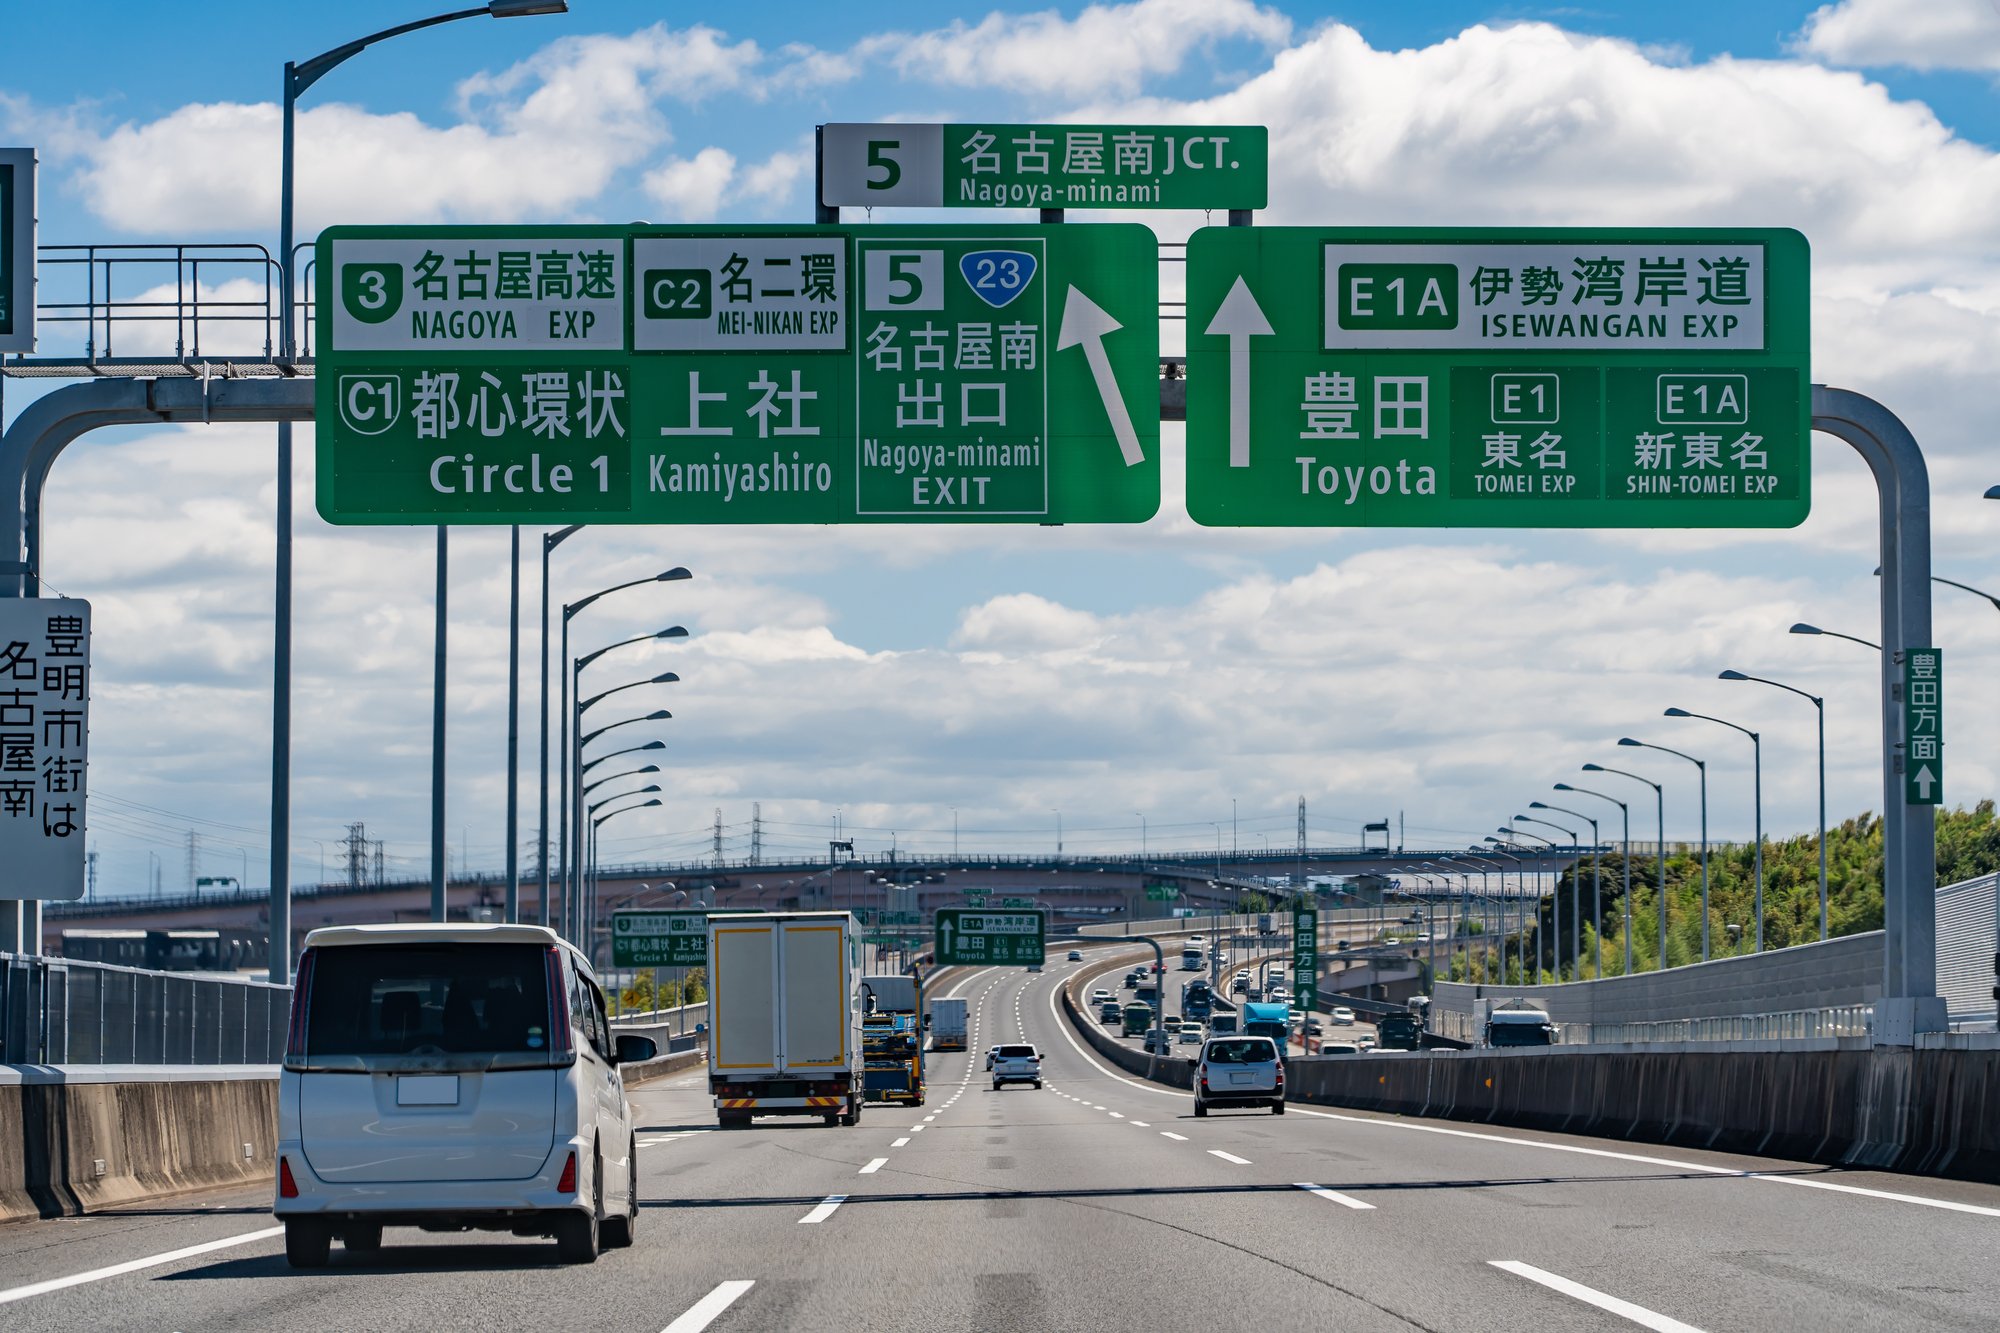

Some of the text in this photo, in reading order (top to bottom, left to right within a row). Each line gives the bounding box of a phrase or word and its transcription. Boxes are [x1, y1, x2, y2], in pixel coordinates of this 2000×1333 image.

[866, 140, 901, 191] 5
[960, 178, 1161, 207] Nagoya-minami
[358, 270, 387, 310] 3
[412, 249, 616, 301] 名古屋高速
[652, 278, 701, 309] C2
[719, 252, 838, 304] 名二環
[888, 254, 923, 305] 5
[975, 258, 1023, 290] 23
[1468, 255, 1752, 307] 伊勢湾岸道
[1350, 277, 1449, 316] E1A
[412, 310, 596, 339] NAGOYA EXP
[717, 310, 839, 335] MEI-NIKAN EXP
[1482, 313, 1739, 338] ISEWANGAN EXP
[865, 320, 1039, 372] 名古屋南
[347, 381, 394, 420] C1
[410, 370, 626, 440] 都心環状
[660, 369, 821, 439] 上社
[896, 378, 1007, 429] 出口
[1299, 371, 1429, 440] 豊田
[1503, 384, 1544, 414] E1
[1666, 384, 1741, 414] E1A
[864, 436, 1040, 475] Nagoya-minami
[1480, 430, 1566, 470] 東名
[1634, 431, 1768, 470] 新東名
[429, 453, 609, 494] Circle 1
[649, 451, 832, 503] Kamiyashiro
[913, 476, 991, 505] EXIT
[1295, 456, 1436, 505] Toyota
[1474, 474, 1576, 493] TOMEI EXP
[1626, 475, 1779, 494] SHIN-TOMEI EXP
[42, 615, 85, 838] 豊明市街は
[1911, 653, 1937, 760] 豊田方面
[0, 641, 38, 818] 名古屋南
[634, 954, 660, 962] Circle
[676, 938, 705, 951] 上社
[956, 951, 985, 961] Toyota
[1297, 914, 1314, 985] 豊田方面
